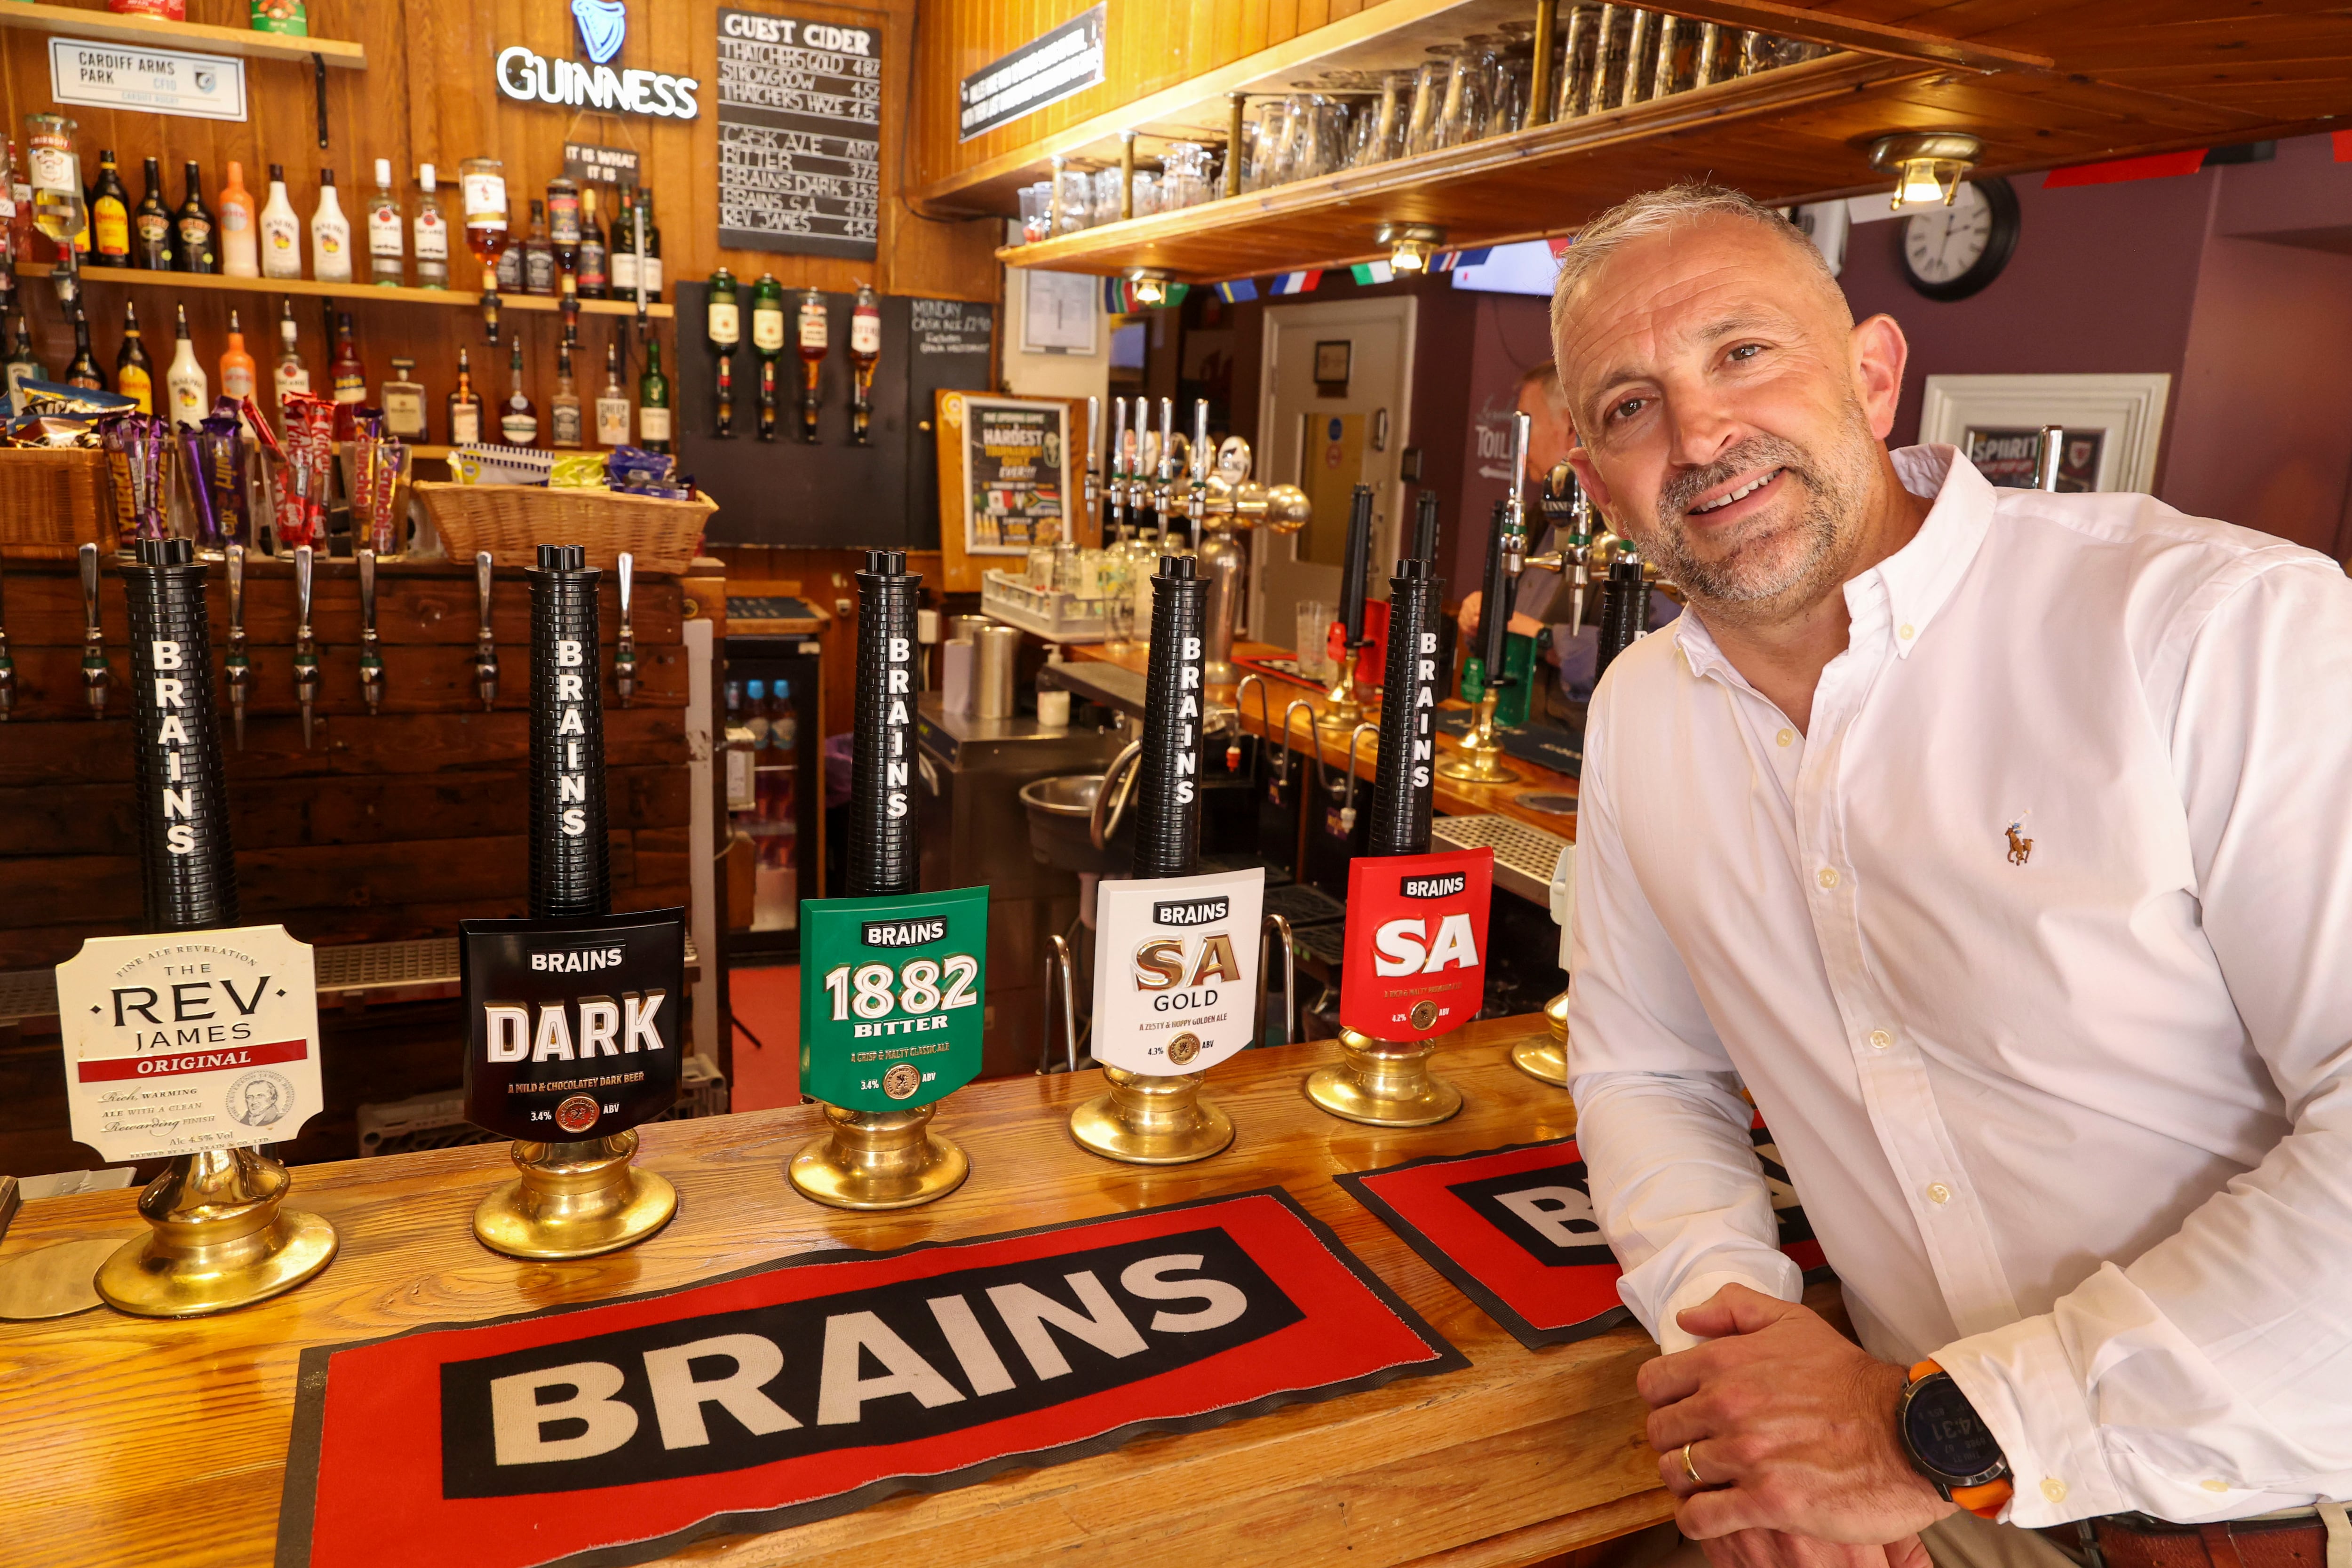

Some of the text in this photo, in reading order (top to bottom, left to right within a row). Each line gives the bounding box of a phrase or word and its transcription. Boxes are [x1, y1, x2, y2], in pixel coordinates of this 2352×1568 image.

[724, 14, 870, 56] GUEST CIDER
[79, 51, 175, 75] CARDIFF ARMS
[720, 40, 806, 70] THATCHERS
[80, 68, 114, 84] PARK
[153, 78, 176, 91] CF10
[497, 46, 698, 119] GUINNESS
[721, 62, 816, 91] STRONGBOW
[720, 82, 803, 111] THATCHERS
[807, 94, 844, 114] HAZE
[783, 132, 823, 155] ALE
[566, 146, 637, 169] IT IS WHAT
[723, 143, 793, 172] BITTER
[587, 165, 616, 182] IT IS
[723, 167, 792, 190] BRAINS
[795, 175, 842, 197] DARK
[723, 187, 783, 210] BRAINS
[723, 206, 752, 227] REV
[758, 211, 811, 233] JAMES
[983, 429, 1044, 446] HARDEST
[109, 453, 137, 532] YORKIE
[1176, 637, 1201, 805] BRAINS
[1412, 632, 1437, 788] BRAINS
[557, 640, 586, 836] BRAINS
[886, 638, 910, 818] BRAINS
[152, 640, 196, 855] BRAINS
[1406, 877, 1464, 897] BRAINS
[1160, 902, 1226, 924] BRAINS
[868, 922, 944, 945] BRAINS
[1373, 913, 1479, 977] SA
[116, 944, 258, 978] FINE ALE REVELATION
[163, 963, 211, 976] THE
[531, 947, 622, 972] BRAINS
[1130, 930, 1241, 992] SA
[823, 952, 978, 1021] 1882
[109, 975, 272, 1027] REV
[1154, 989, 1218, 1012] GOLD
[483, 988, 666, 1063] DARK
[854, 1013, 949, 1038] BITTER
[1172, 1019, 1192, 1028] HOPPY
[1192, 1015, 1216, 1026] GOLDEN
[1216, 1013, 1227, 1021] ALE
[1392, 1008, 1450, 1022] 4.2% ABV
[135, 1022, 251, 1051] JAMES
[1148, 1040, 1214, 1056] 4.3% ABV
[137, 1051, 251, 1075] ORIGINAL
[851, 1042, 950, 1062] A CRISP & MALTY CLASSIC ALE
[508, 1071, 644, 1094] A MILD & CHOCOLATEY DARK BEER
[860, 1072, 937, 1090] 3.4% ABV
[97, 1086, 198, 1103] Rich, WARMING
[102, 1109, 123, 1118] ALE
[127, 1106, 155, 1115] WITH
[168, 1101, 203, 1112] CLEAN
[531, 1104, 620, 1122] 3.4% ABV
[100, 1114, 215, 1137] Rewarding FINISH
[169, 1130, 233, 1146] Alc 4.5% Vol
[199, 1143, 225, 1151] BRAIN
[490, 1252, 1248, 1468] BRAINS
